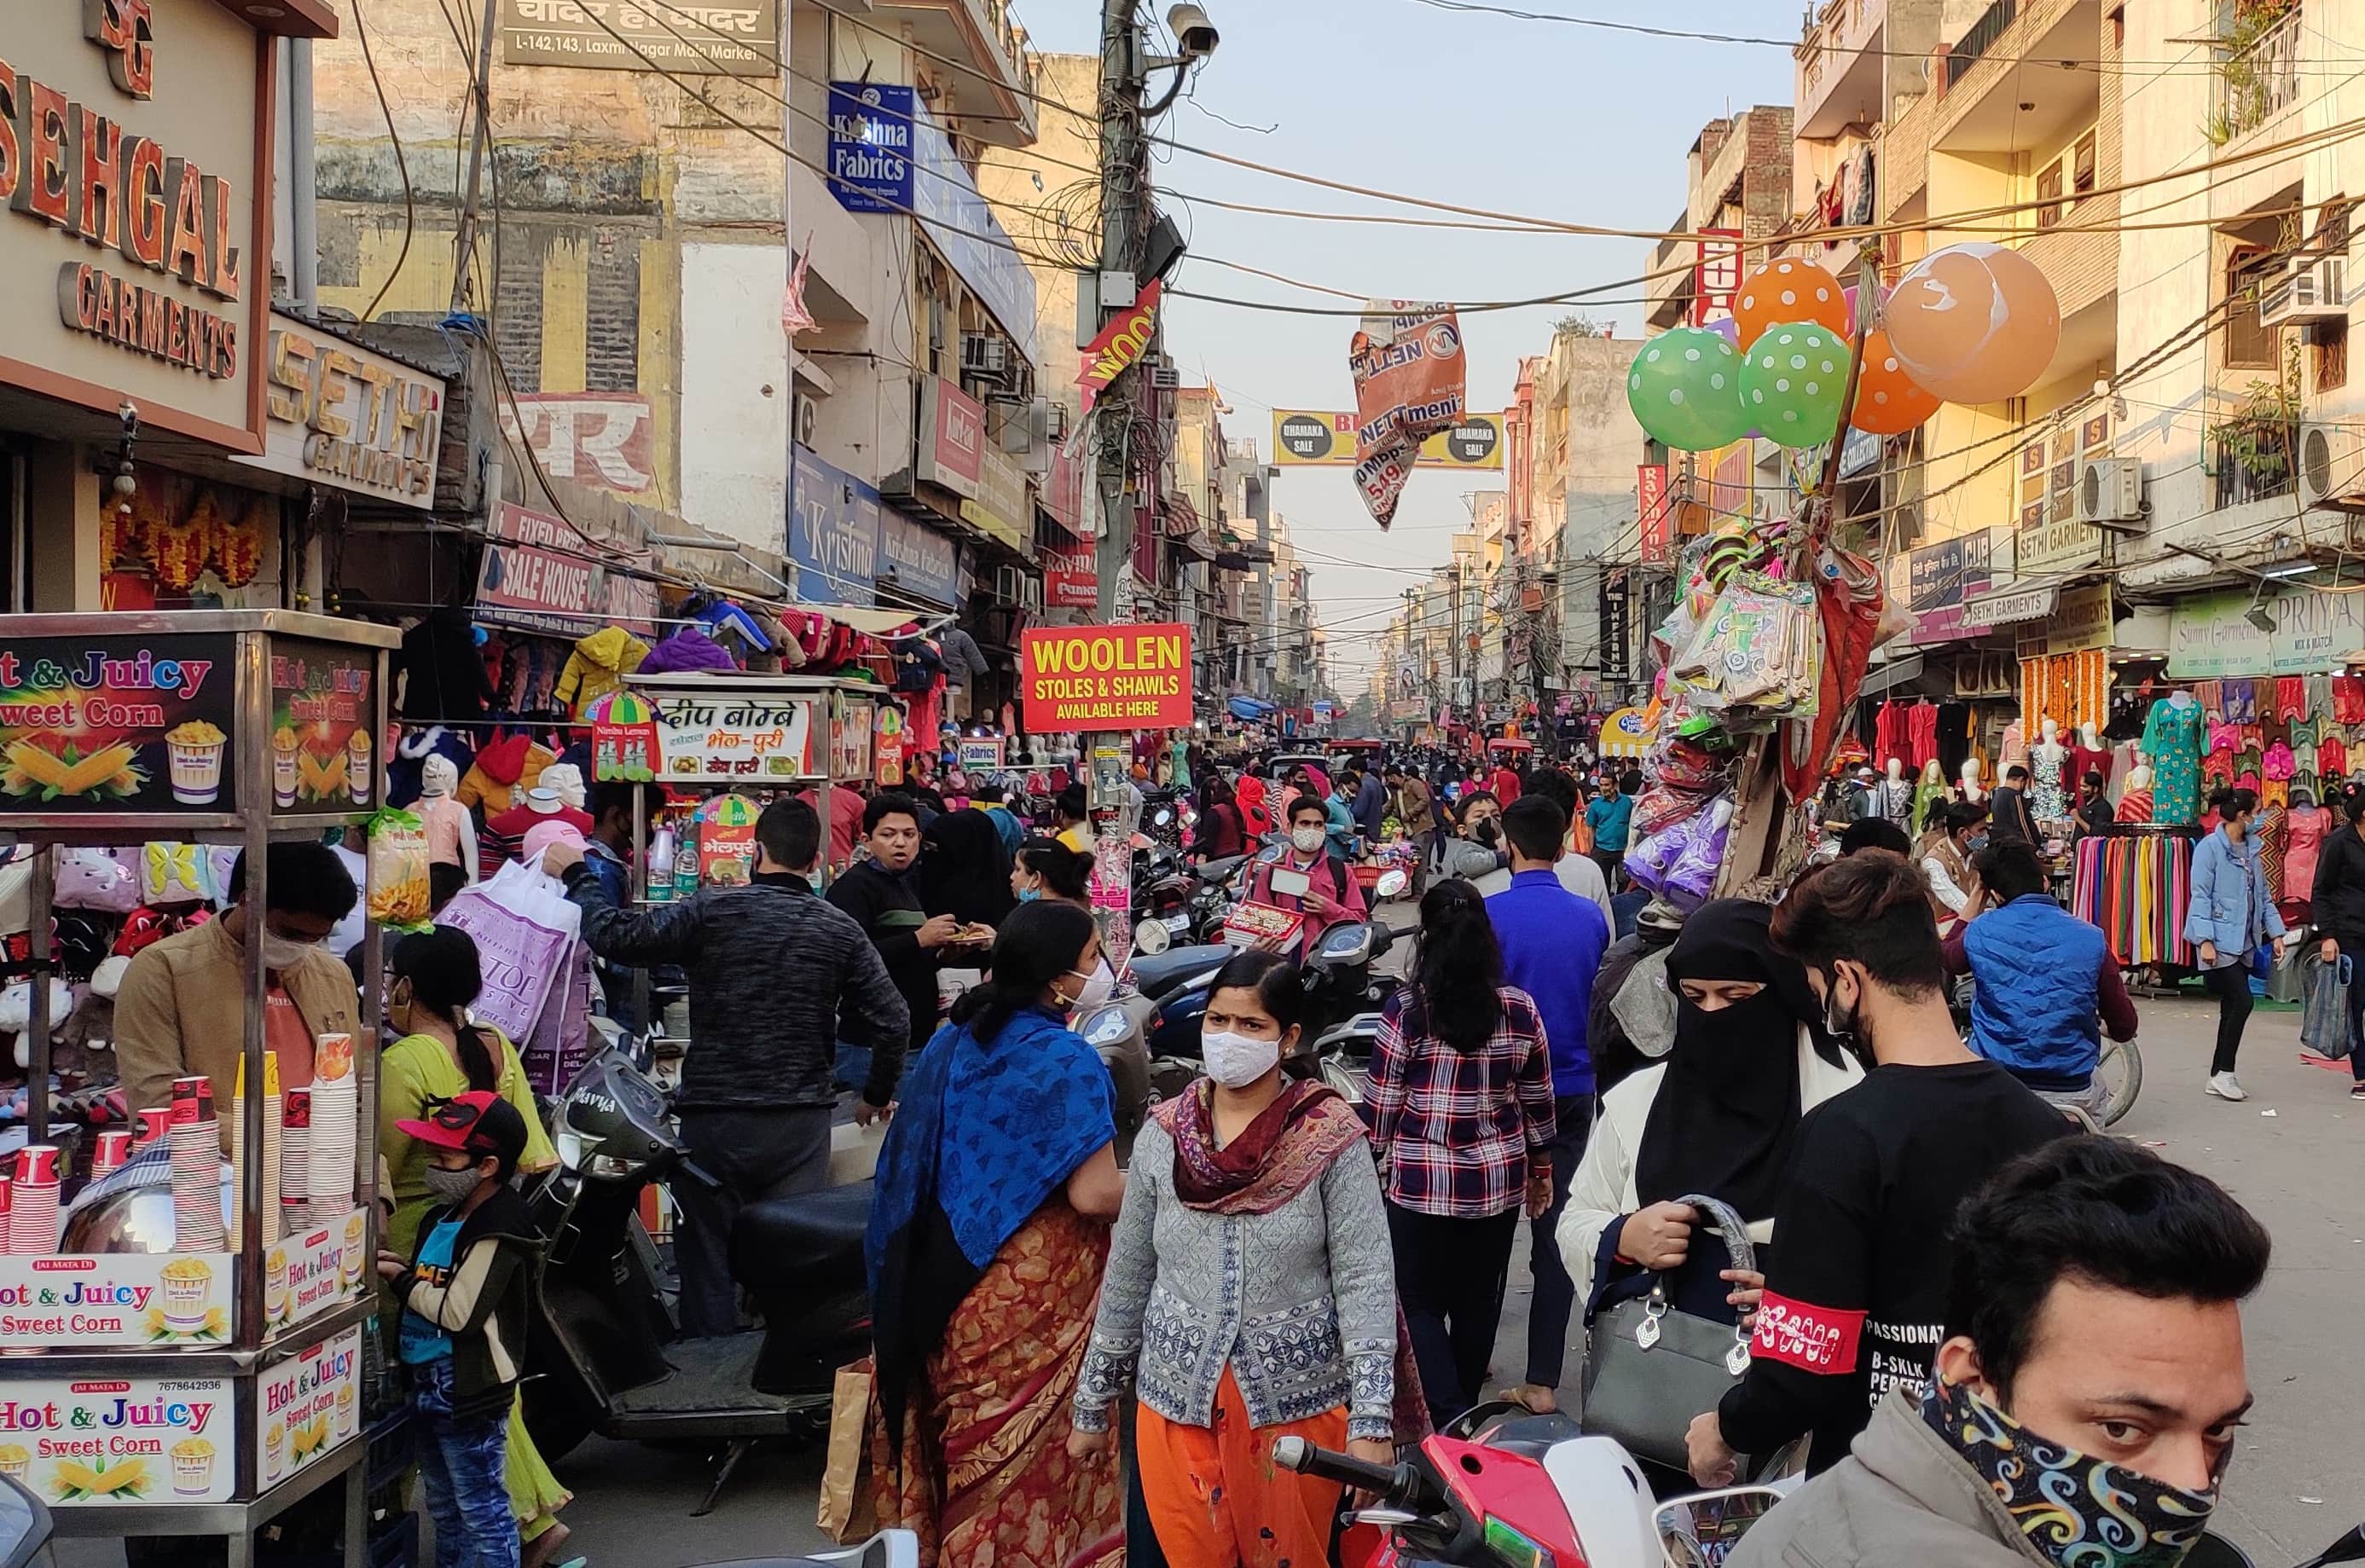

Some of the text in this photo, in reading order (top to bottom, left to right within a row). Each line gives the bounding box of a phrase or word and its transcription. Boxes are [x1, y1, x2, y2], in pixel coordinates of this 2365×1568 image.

[515, 33, 582, 54] L-142,143,
[674, 44, 708, 59] Main
[835, 148, 906, 182] Fabrics
[70, 261, 238, 380] GARMENTS
[1284, 424, 1324, 438] DHAMAKA
[1294, 440, 1314, 453] SALE
[1455, 427, 1494, 442] DHAMAKA
[1464, 443, 1485, 457] SALE
[1643, 467, 1662, 562] Raymond
[517, 515, 554, 547] FIXED
[805, 499, 873, 592] Krishna
[2020, 519, 2101, 561] SETHI GARMENT
[502, 549, 542, 601] SALE
[541, 559, 588, 611] HOUSE
[1057, 582, 1098, 596] Panka
[1973, 593, 2042, 622] SETHI GARMENTS
[2277, 593, 2353, 636] PRIYA
[1610, 604, 1621, 673] INFERNO
[2177, 619, 2210, 655] Sunny
[2311, 636, 2333, 649] MATCH
[1031, 635, 1182, 674] WOOLEN
[32, 658, 63, 687] &
[72, 649, 212, 699] Juicy
[272, 655, 307, 690] Hot
[322, 659, 372, 703] Juicy
[1035, 674, 1180, 701] STOLES & SHAWLS
[0, 697, 165, 728] weet Corn
[290, 693, 356, 722] Sweet Corn
[660, 698, 718, 730] दीप
[1056, 700, 1160, 720] AVAILABLE HERE
[965, 746, 996, 760] Fabrics
[35, 1261, 51, 1270] JAI
[287, 1246, 343, 1288] Hot & Juicy
[0, 1282, 37, 1306] ot
[38, 1287, 61, 1307] &
[64, 1281, 155, 1311] Juicy
[297, 1279, 335, 1310] Sweet Corn
[2, 1315, 124, 1335] Sweet Corn
[1871, 1351, 1925, 1379] B-SKLK
[89, 1383, 113, 1392] MATA
[158, 1380, 222, 1392] 7678642936
[266, 1374, 296, 1416] Hot
[299, 1370, 310, 1397] &
[310, 1349, 355, 1391] Juicy
[1870, 1373, 1928, 1396] PERFEC
[70, 1407, 97, 1429] &
[101, 1397, 217, 1434] Juicy
[286, 1392, 334, 1432] Sweet Corn
[38, 1436, 163, 1457] Sweet Corn
